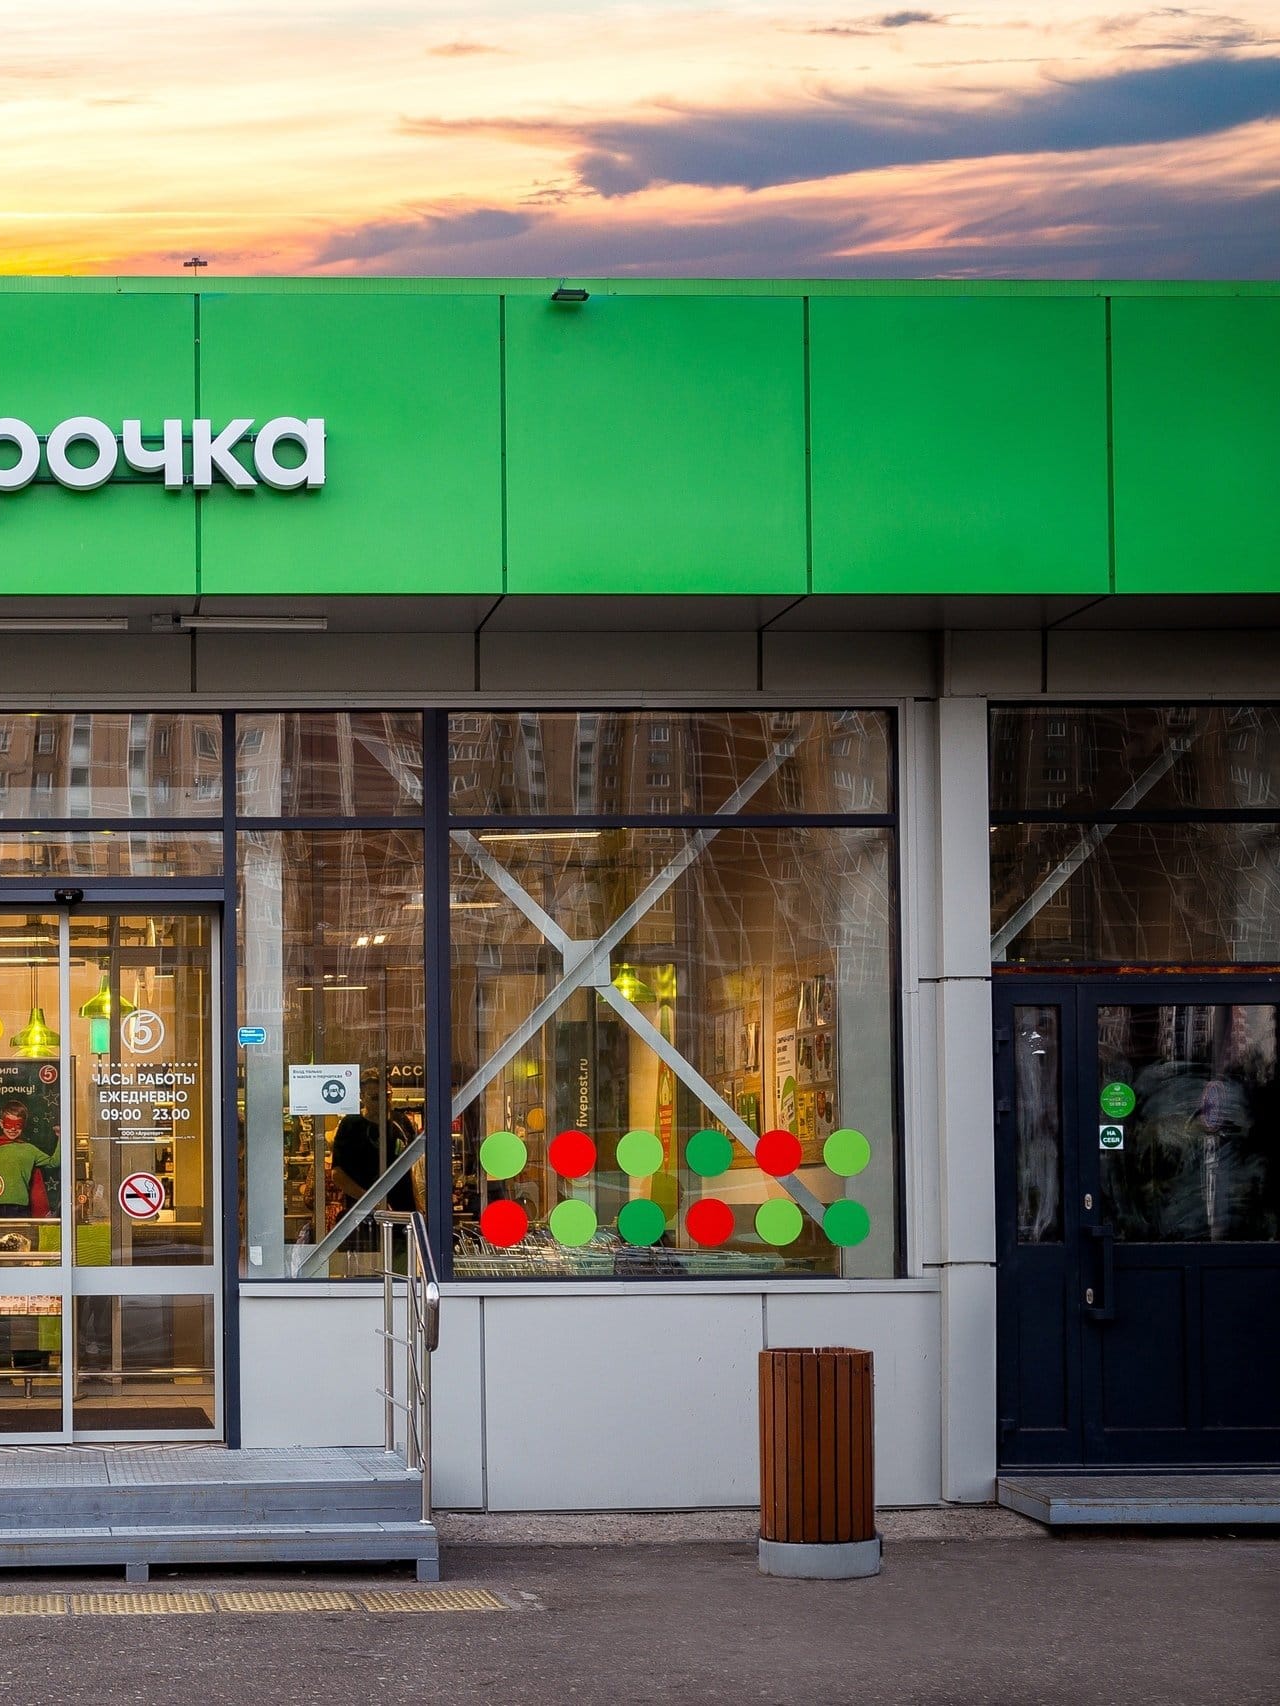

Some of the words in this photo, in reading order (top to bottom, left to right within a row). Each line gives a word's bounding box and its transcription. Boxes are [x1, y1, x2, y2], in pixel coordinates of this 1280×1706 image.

[390, 1065, 423, 1076] АСС
[91, 1073, 134, 1085] ЧАСЫ
[137, 1073, 196, 1085] РАБОТЫ
[99, 1090, 188, 1104] ЕЖЕДНЕВНО
[576, 1058, 589, 1128] fivepost.ru
[101, 1108, 142, 1120] 09:00
